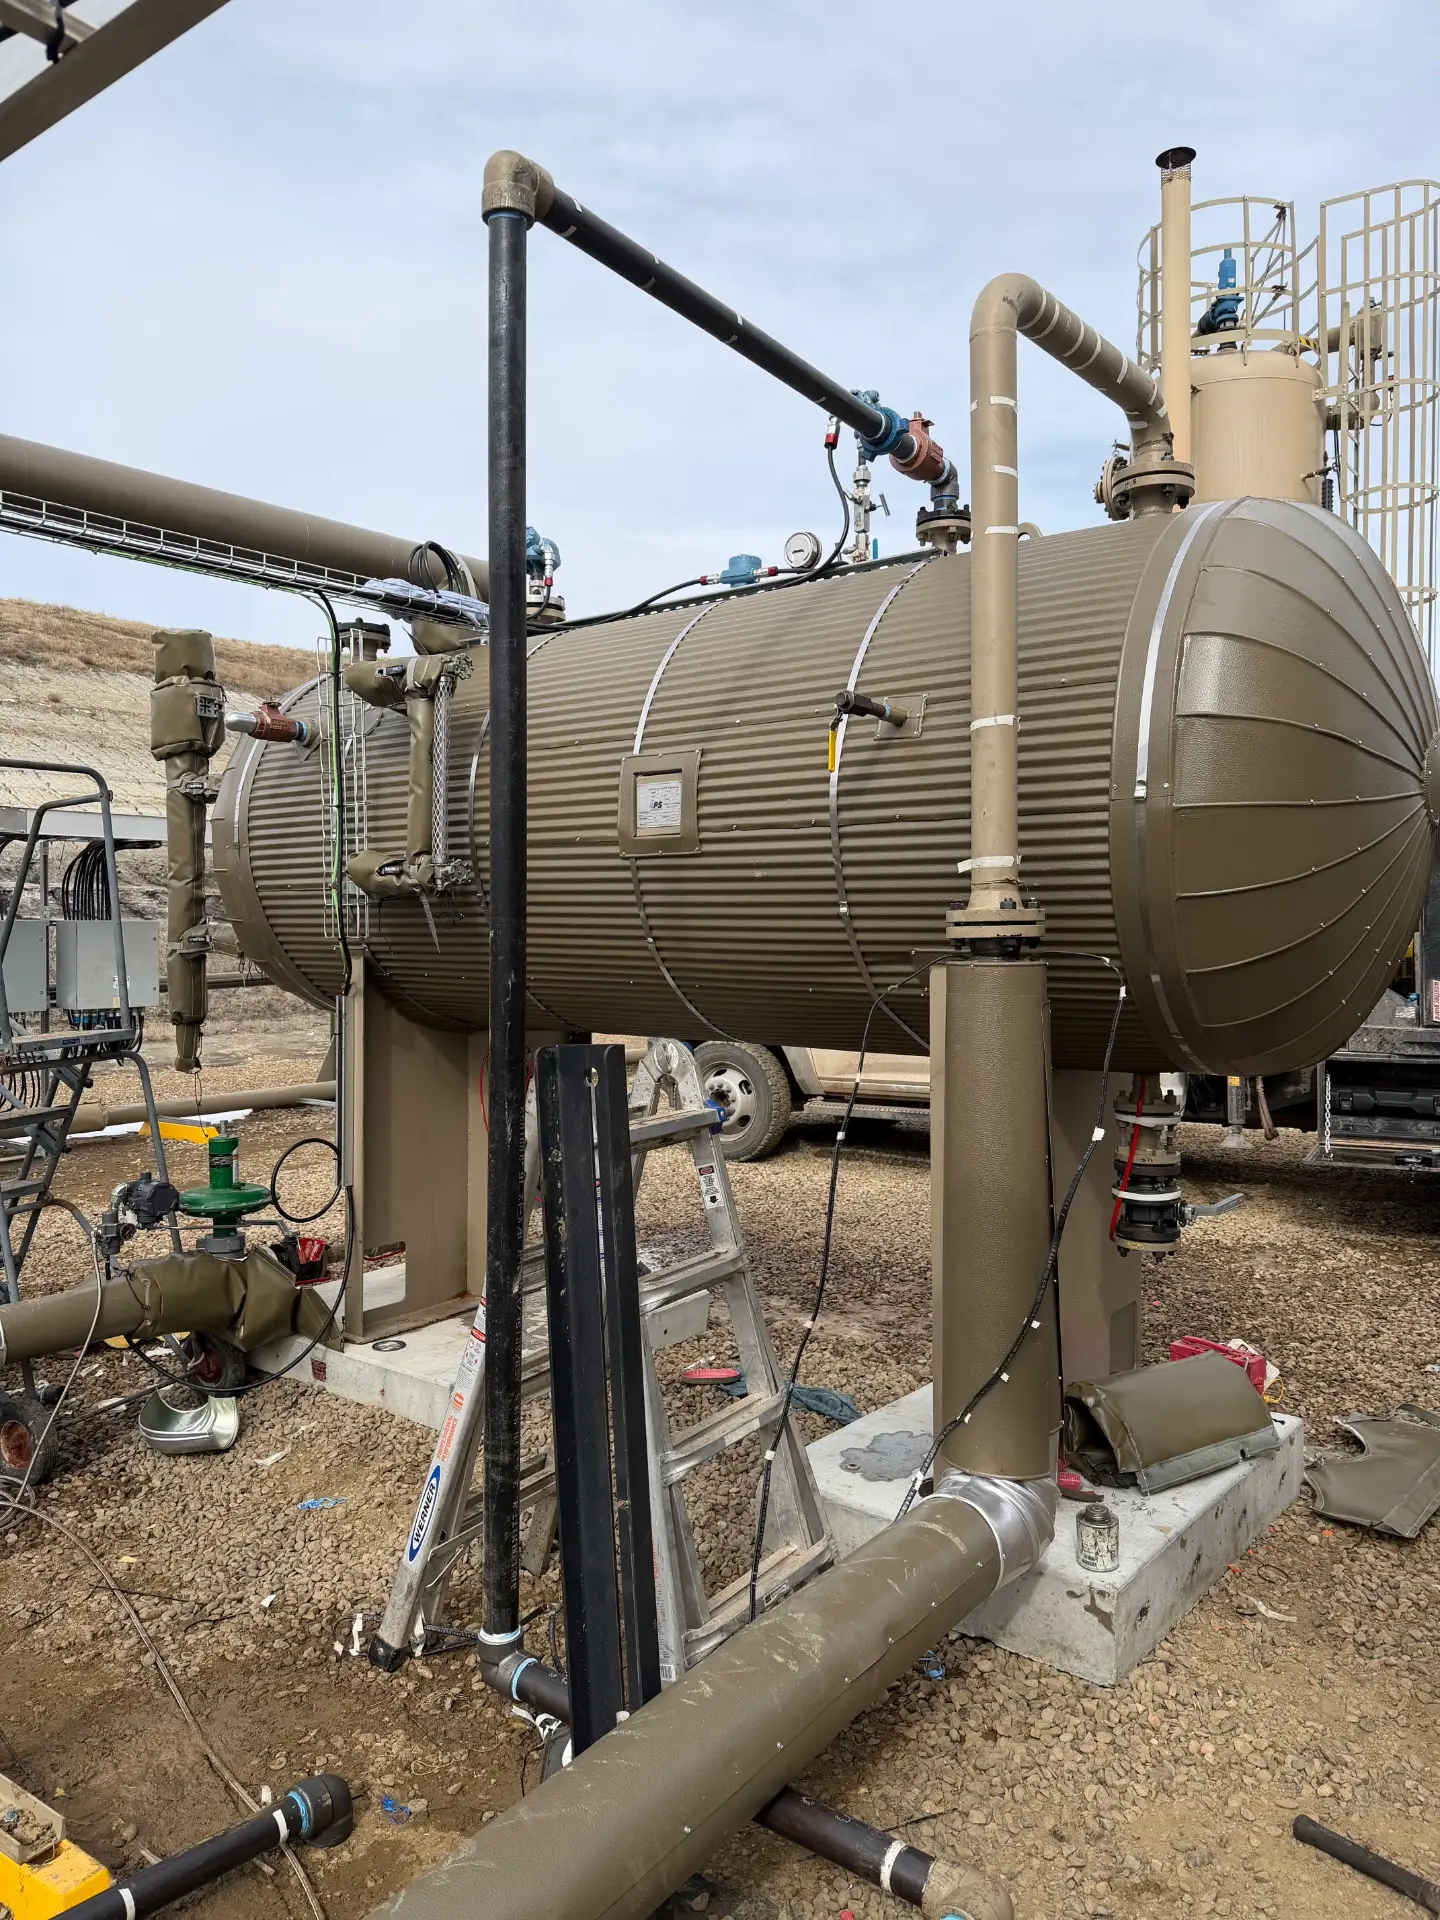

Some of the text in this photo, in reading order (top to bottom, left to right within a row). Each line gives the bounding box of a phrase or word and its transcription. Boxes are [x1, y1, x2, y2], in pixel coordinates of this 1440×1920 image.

[436, 1414, 454, 1459] PROFESSIONAL
[441, 1418, 459, 1463] PERFORMANCE
[413, 1482, 436, 1543] WERNER
